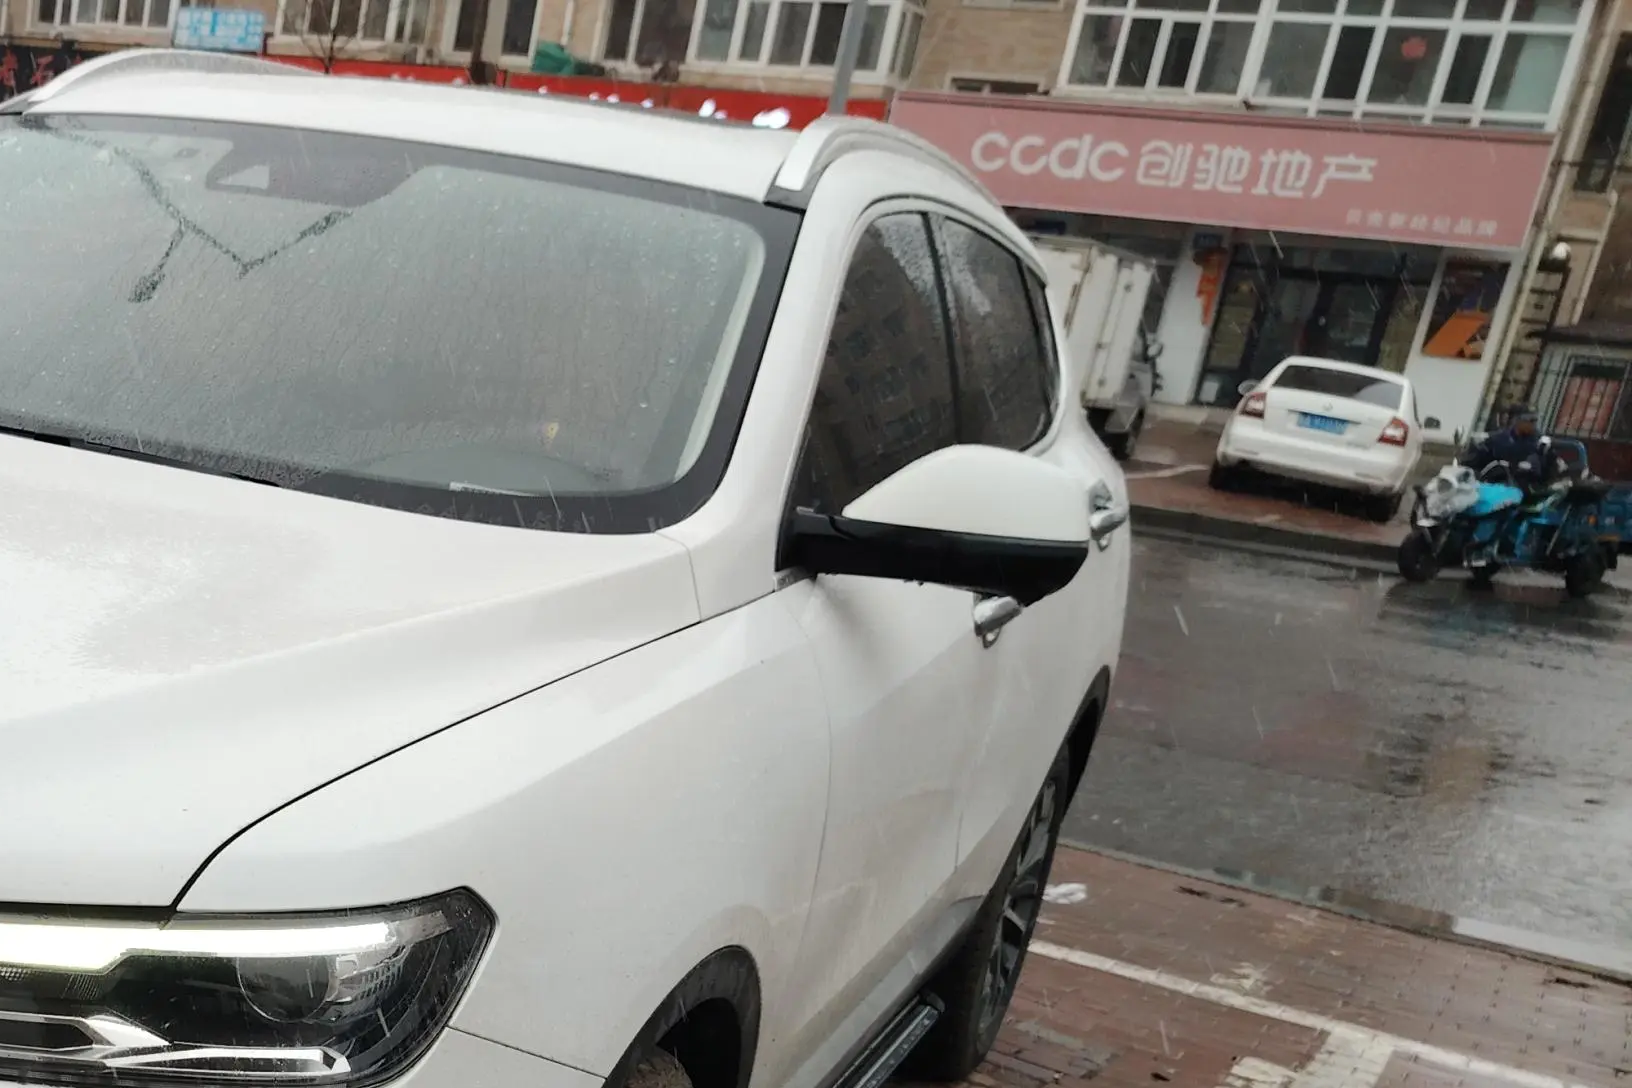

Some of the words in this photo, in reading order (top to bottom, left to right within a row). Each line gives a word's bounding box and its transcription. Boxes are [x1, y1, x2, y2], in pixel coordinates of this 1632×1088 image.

[971, 131, 1129, 182] ccdc
[1136, 140, 1378, 198] 创驰地产
